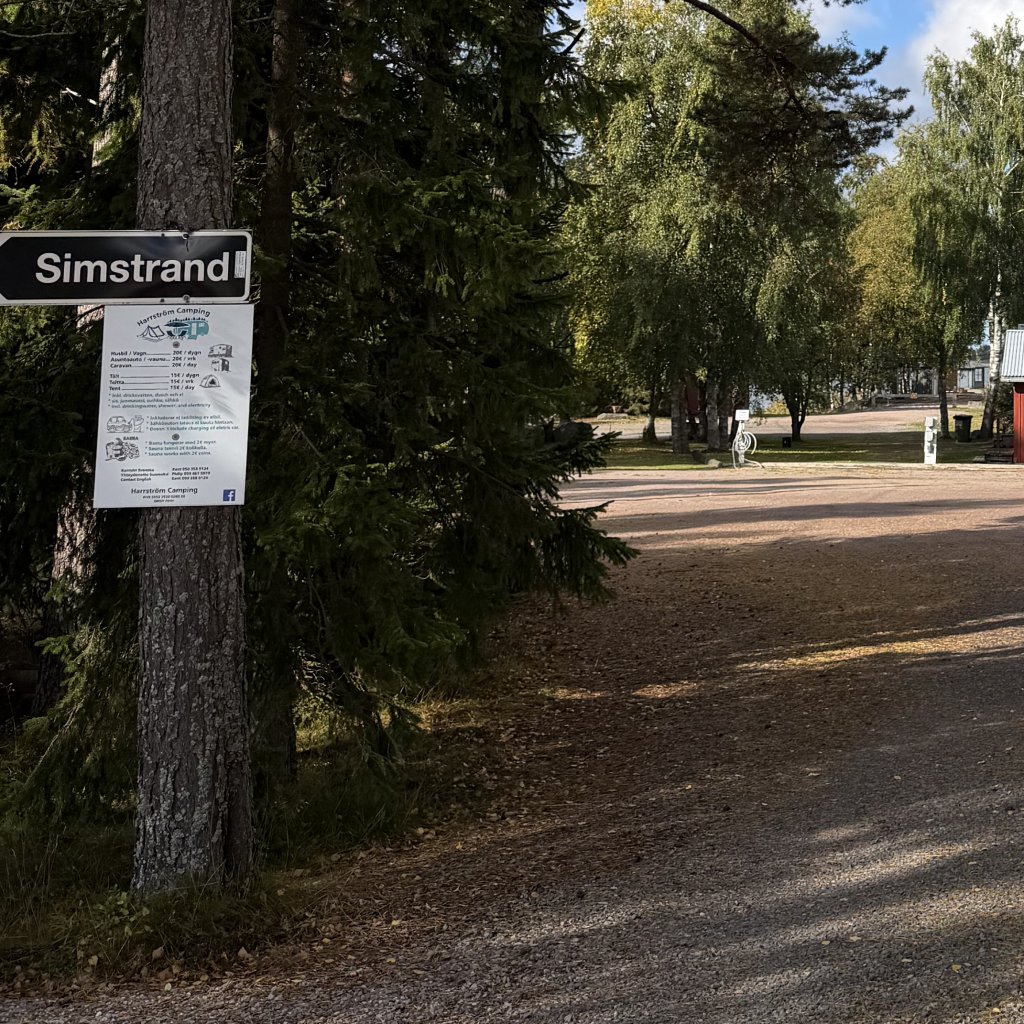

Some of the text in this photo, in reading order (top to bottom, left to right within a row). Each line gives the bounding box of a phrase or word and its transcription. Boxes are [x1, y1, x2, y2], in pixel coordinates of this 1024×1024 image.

[35, 251, 229, 283] Simstrand
[137, 308, 210, 326] Harrström Camping
